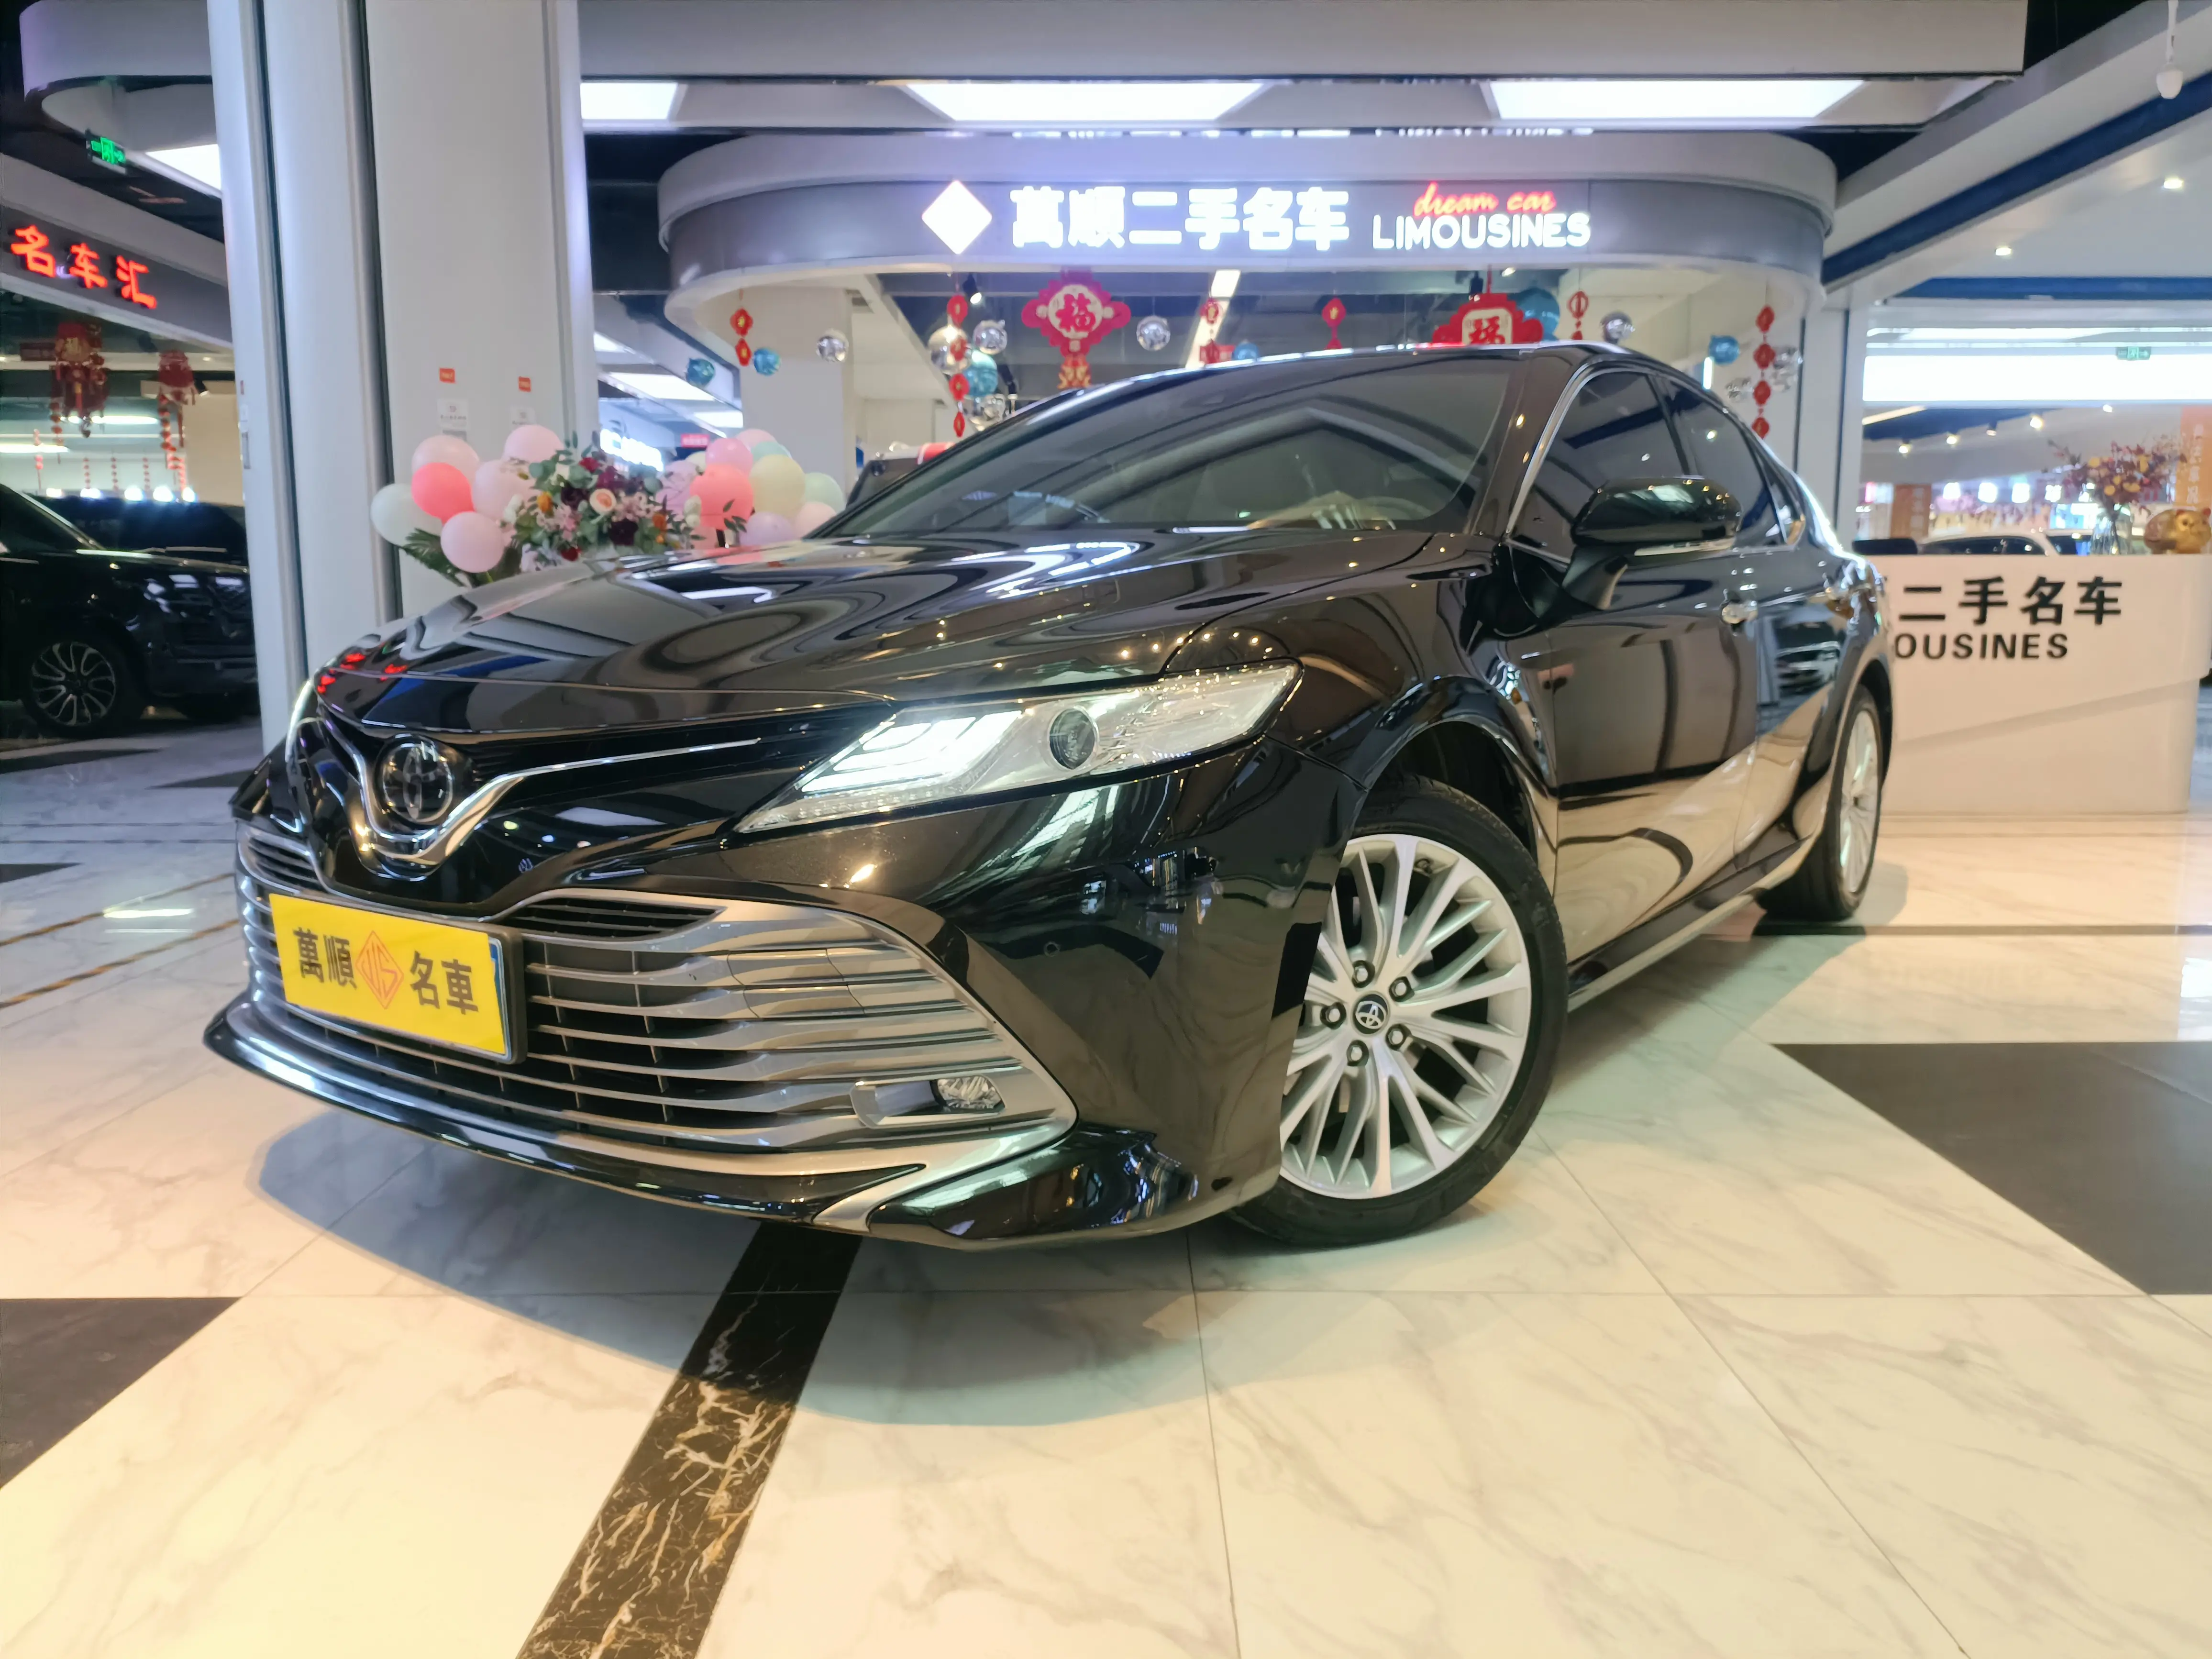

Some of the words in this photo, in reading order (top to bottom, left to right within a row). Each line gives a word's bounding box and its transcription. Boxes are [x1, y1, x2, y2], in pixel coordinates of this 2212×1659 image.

[1415, 182, 1499, 218] dream
[1507, 191, 1557, 213] car
[1372, 212, 1591, 250] LIMOUSINES
[11, 224, 157, 309] 名车汇
[1894, 632, 2068, 660] OUSINES
